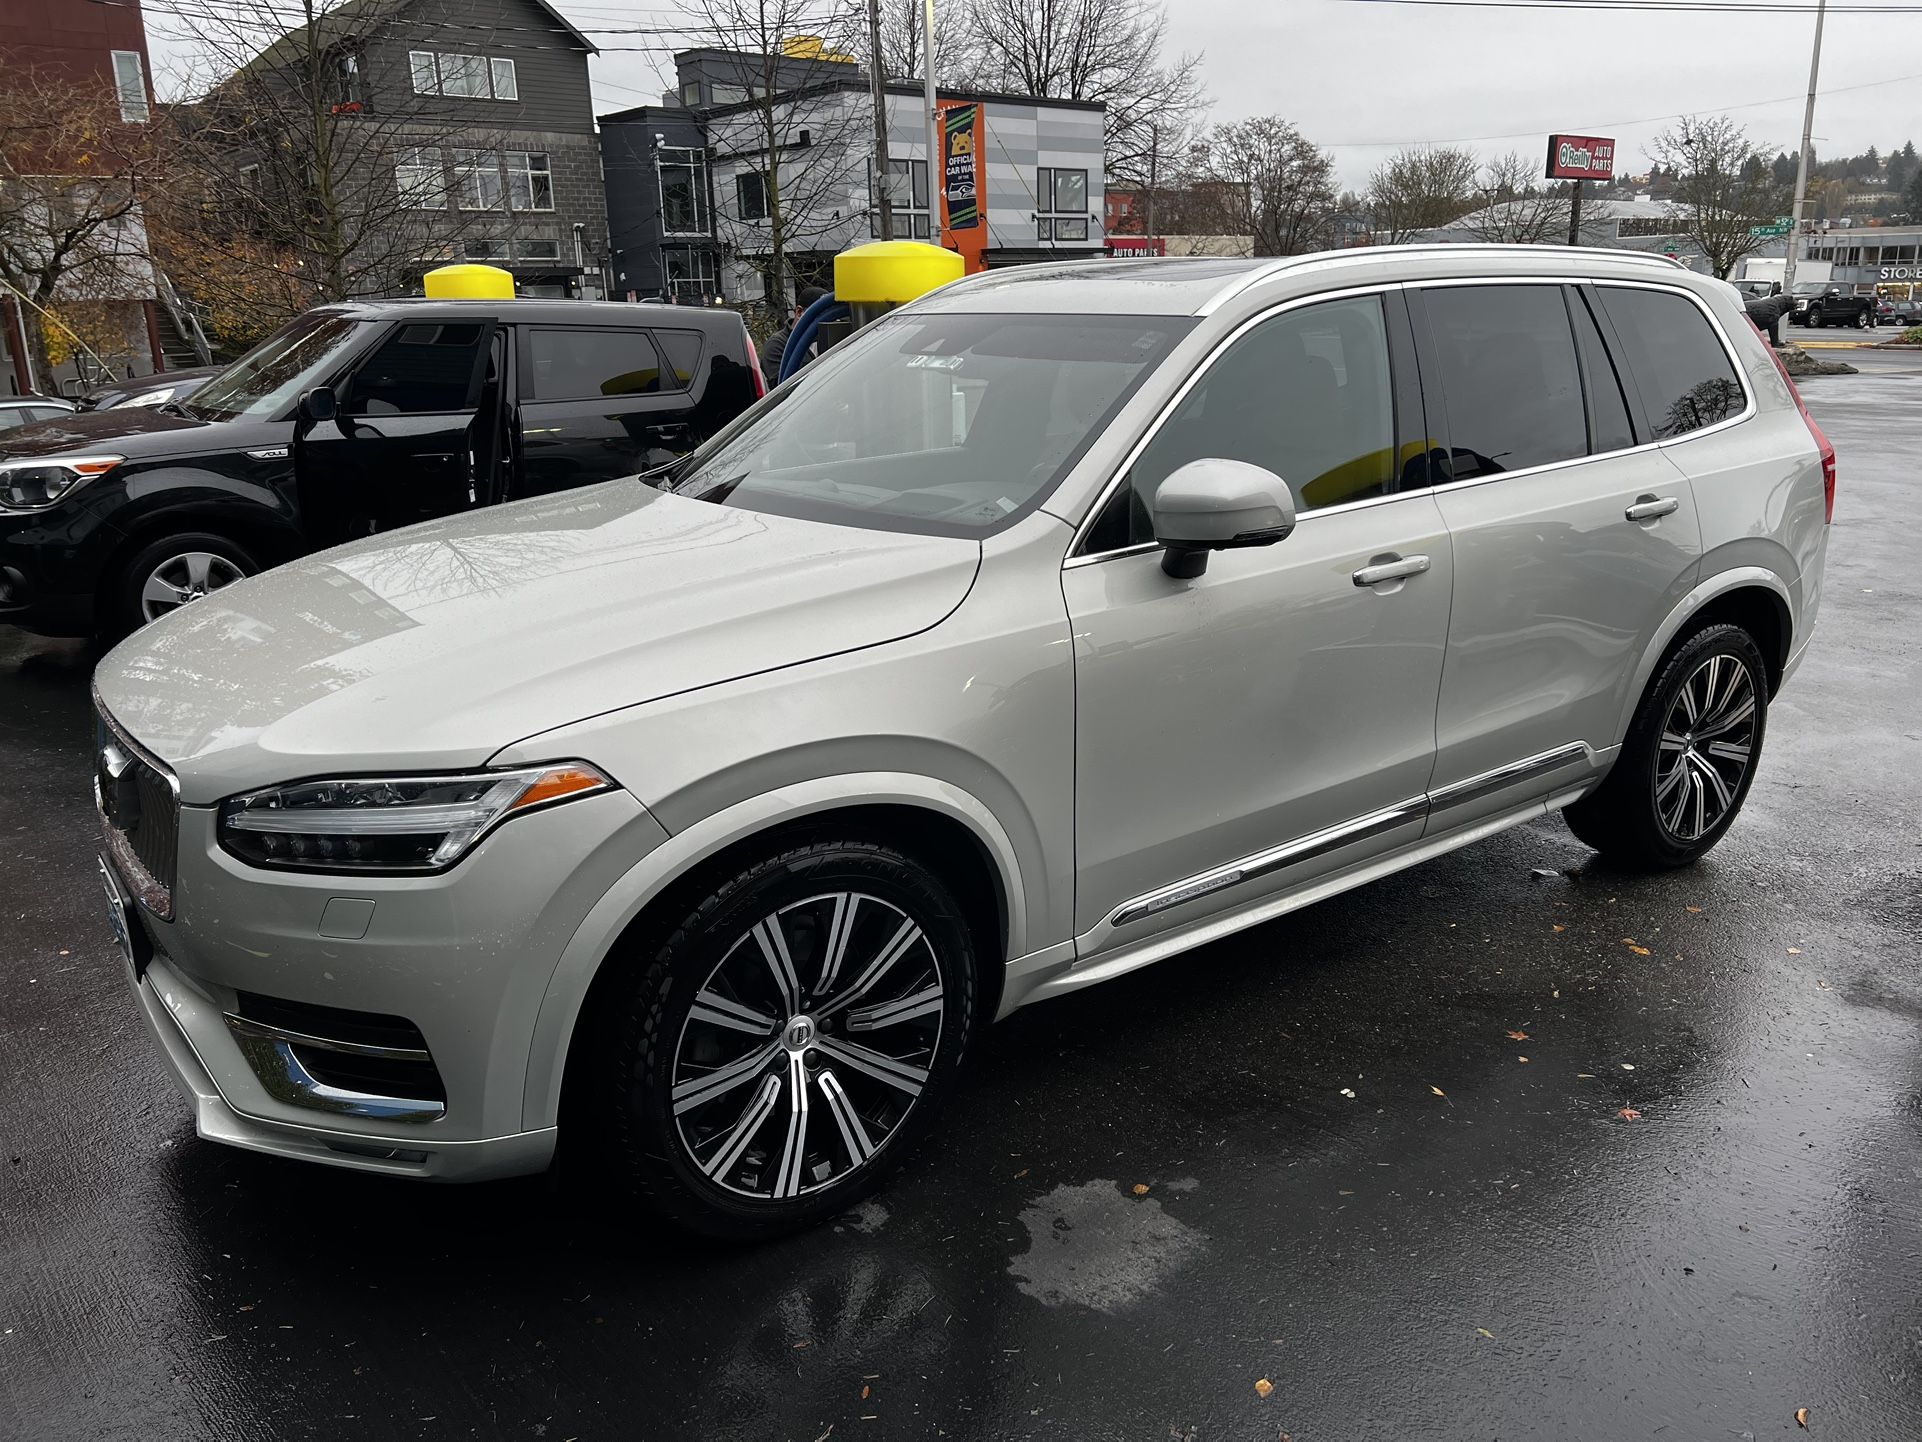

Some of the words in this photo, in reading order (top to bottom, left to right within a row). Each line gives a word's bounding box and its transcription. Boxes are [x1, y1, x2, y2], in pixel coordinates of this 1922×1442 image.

[1559, 142, 1591, 170] O'Reilly
[1594, 145, 1612, 158] AUTO
[946, 166, 961, 176] CAR
[1591, 159, 1612, 171] PARTS
[1112, 248, 1133, 257] AUTO
[1134, 248, 1158, 257] PARS
